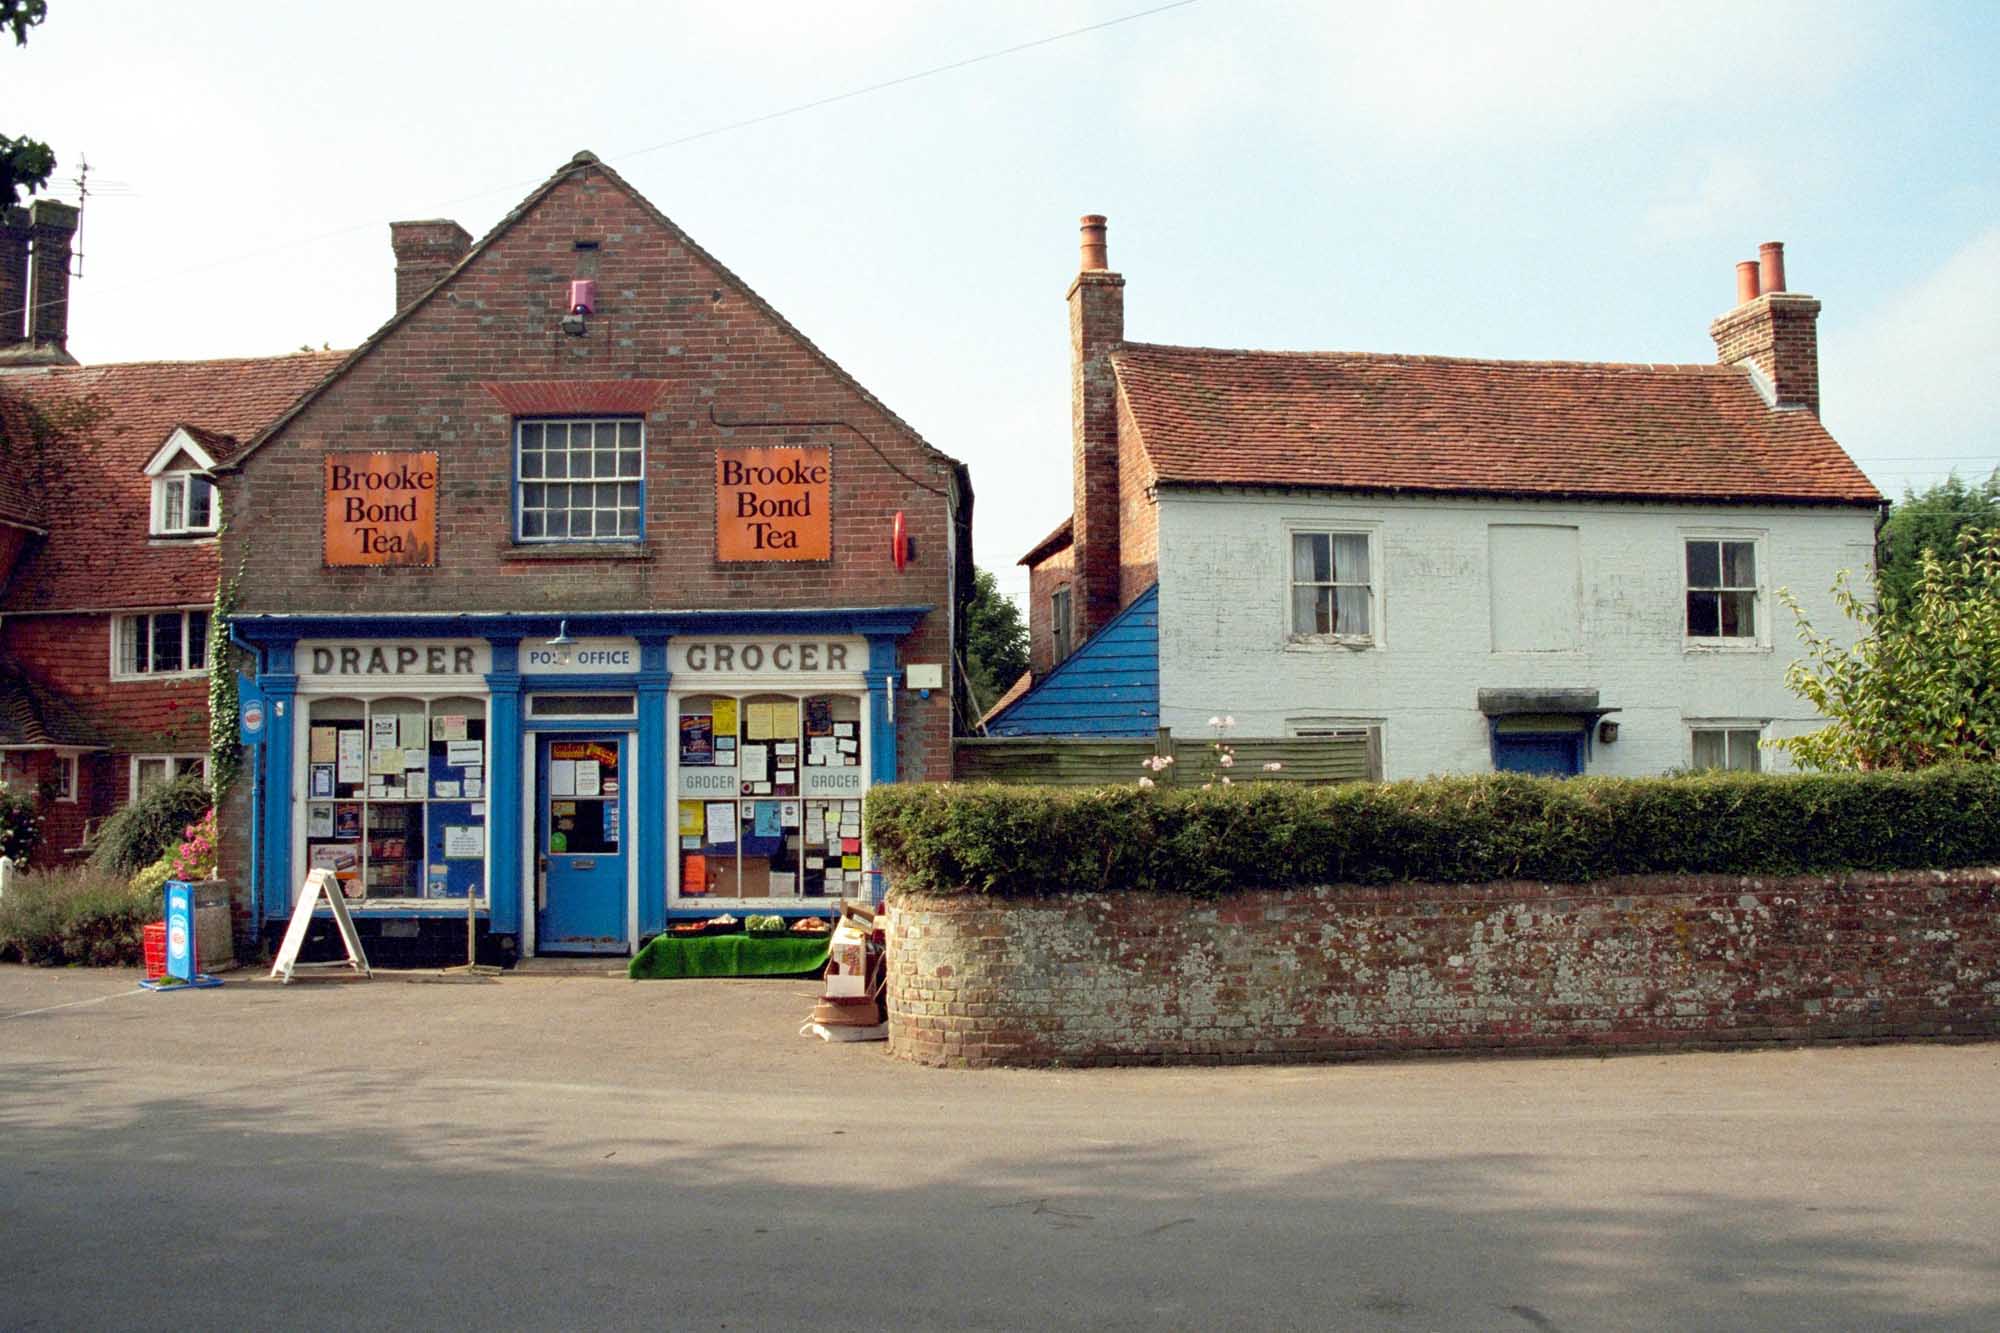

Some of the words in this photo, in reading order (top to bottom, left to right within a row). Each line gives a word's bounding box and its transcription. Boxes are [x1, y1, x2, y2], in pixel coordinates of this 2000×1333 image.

[331, 464, 434, 491] Brooke
[721, 459, 827, 486] Brooke
[344, 496, 418, 523] Bond
[735, 491, 811, 518] Bond
[354, 527, 405, 554] Tea
[746, 522, 799, 550] Tea
[312, 646, 476, 675] DRAPER
[530, 651, 570, 665] POS
[577, 650, 630, 665] OFFICE
[686, 642, 848, 672] GROCER
[686, 775, 735, 789] GROCER
[811, 774, 860, 789] GROCER
